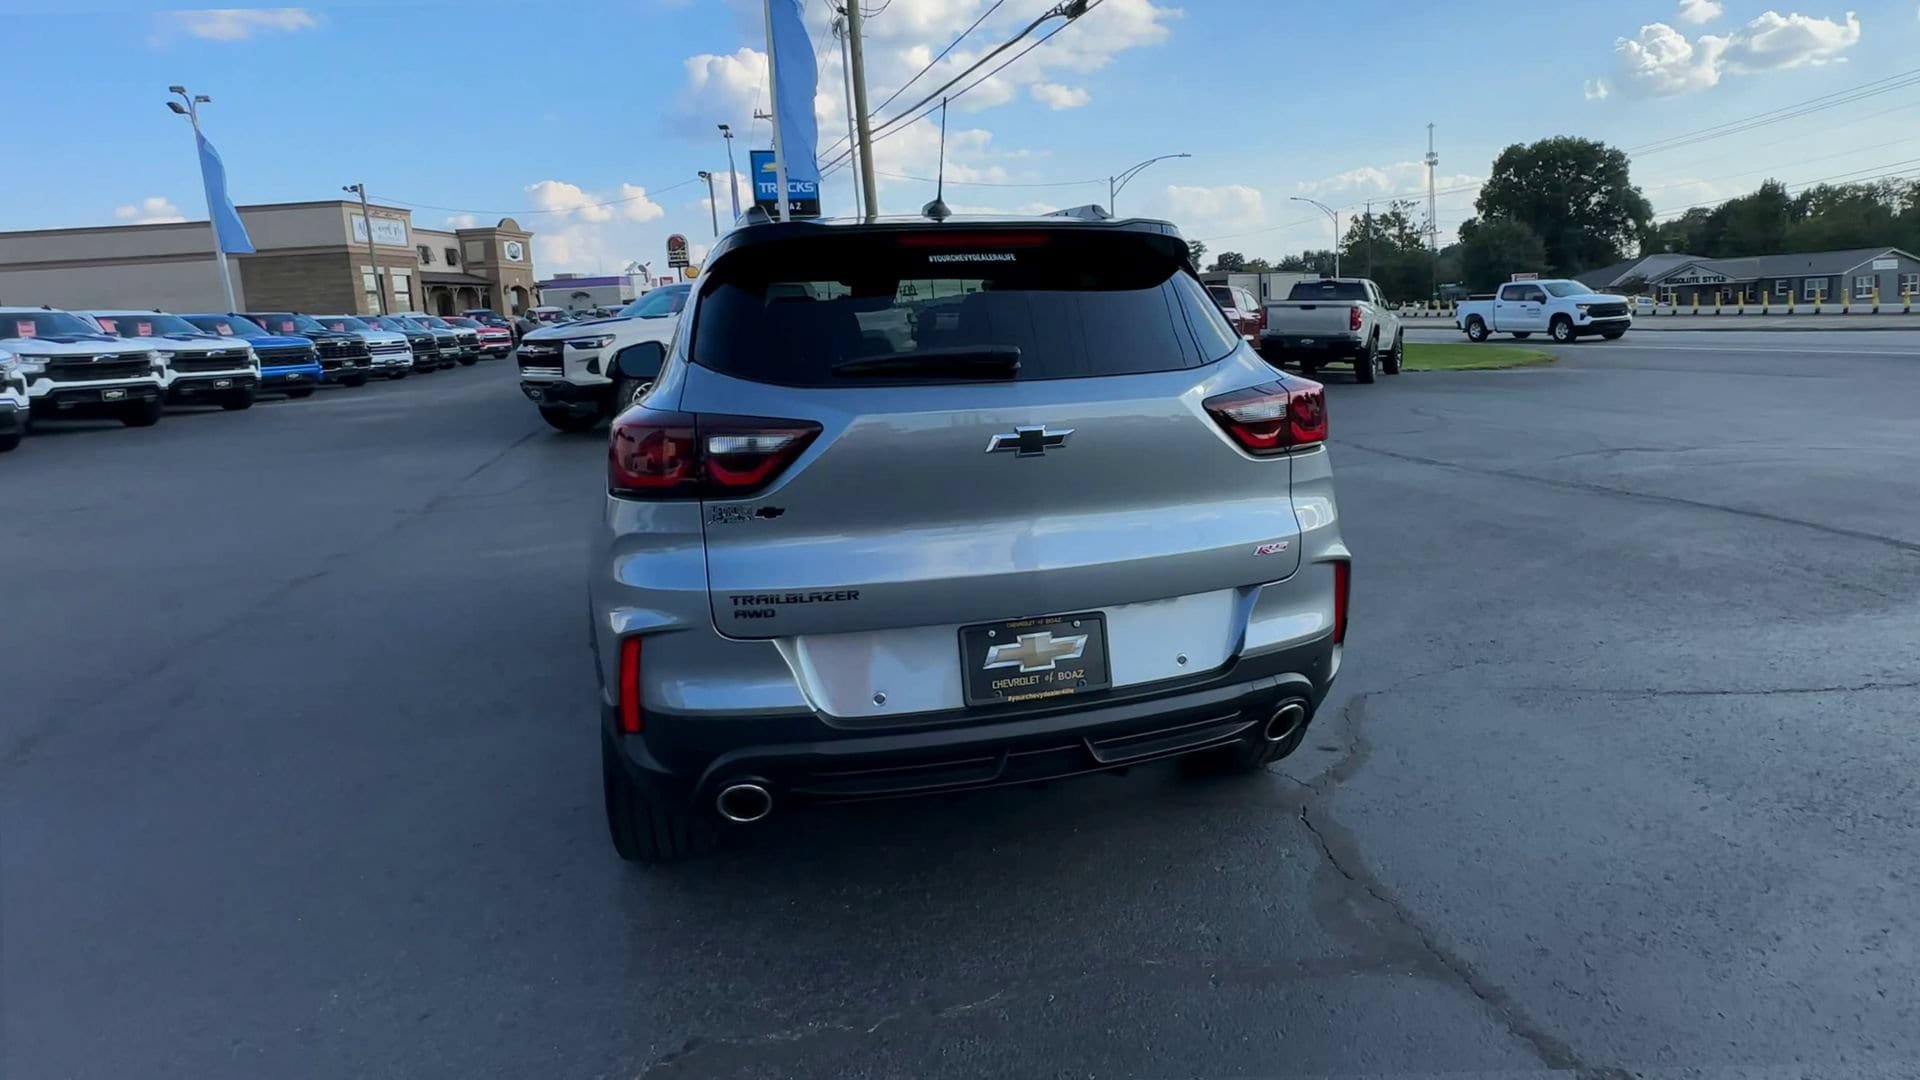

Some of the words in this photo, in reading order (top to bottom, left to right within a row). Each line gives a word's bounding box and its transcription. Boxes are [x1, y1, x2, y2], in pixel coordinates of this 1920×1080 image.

[759, 182, 814, 193] TRCKS
[774, 202, 802, 210] BAZ
[1702, 275, 1727, 283] STYLE
[729, 590, 860, 606] TRAILBLAZER
[734, 608, 776, 619] AWD
[992, 675, 1040, 689] CHEVROLET
[1044, 673, 1054, 683] of
[1057, 669, 1085, 681] BOAZ
